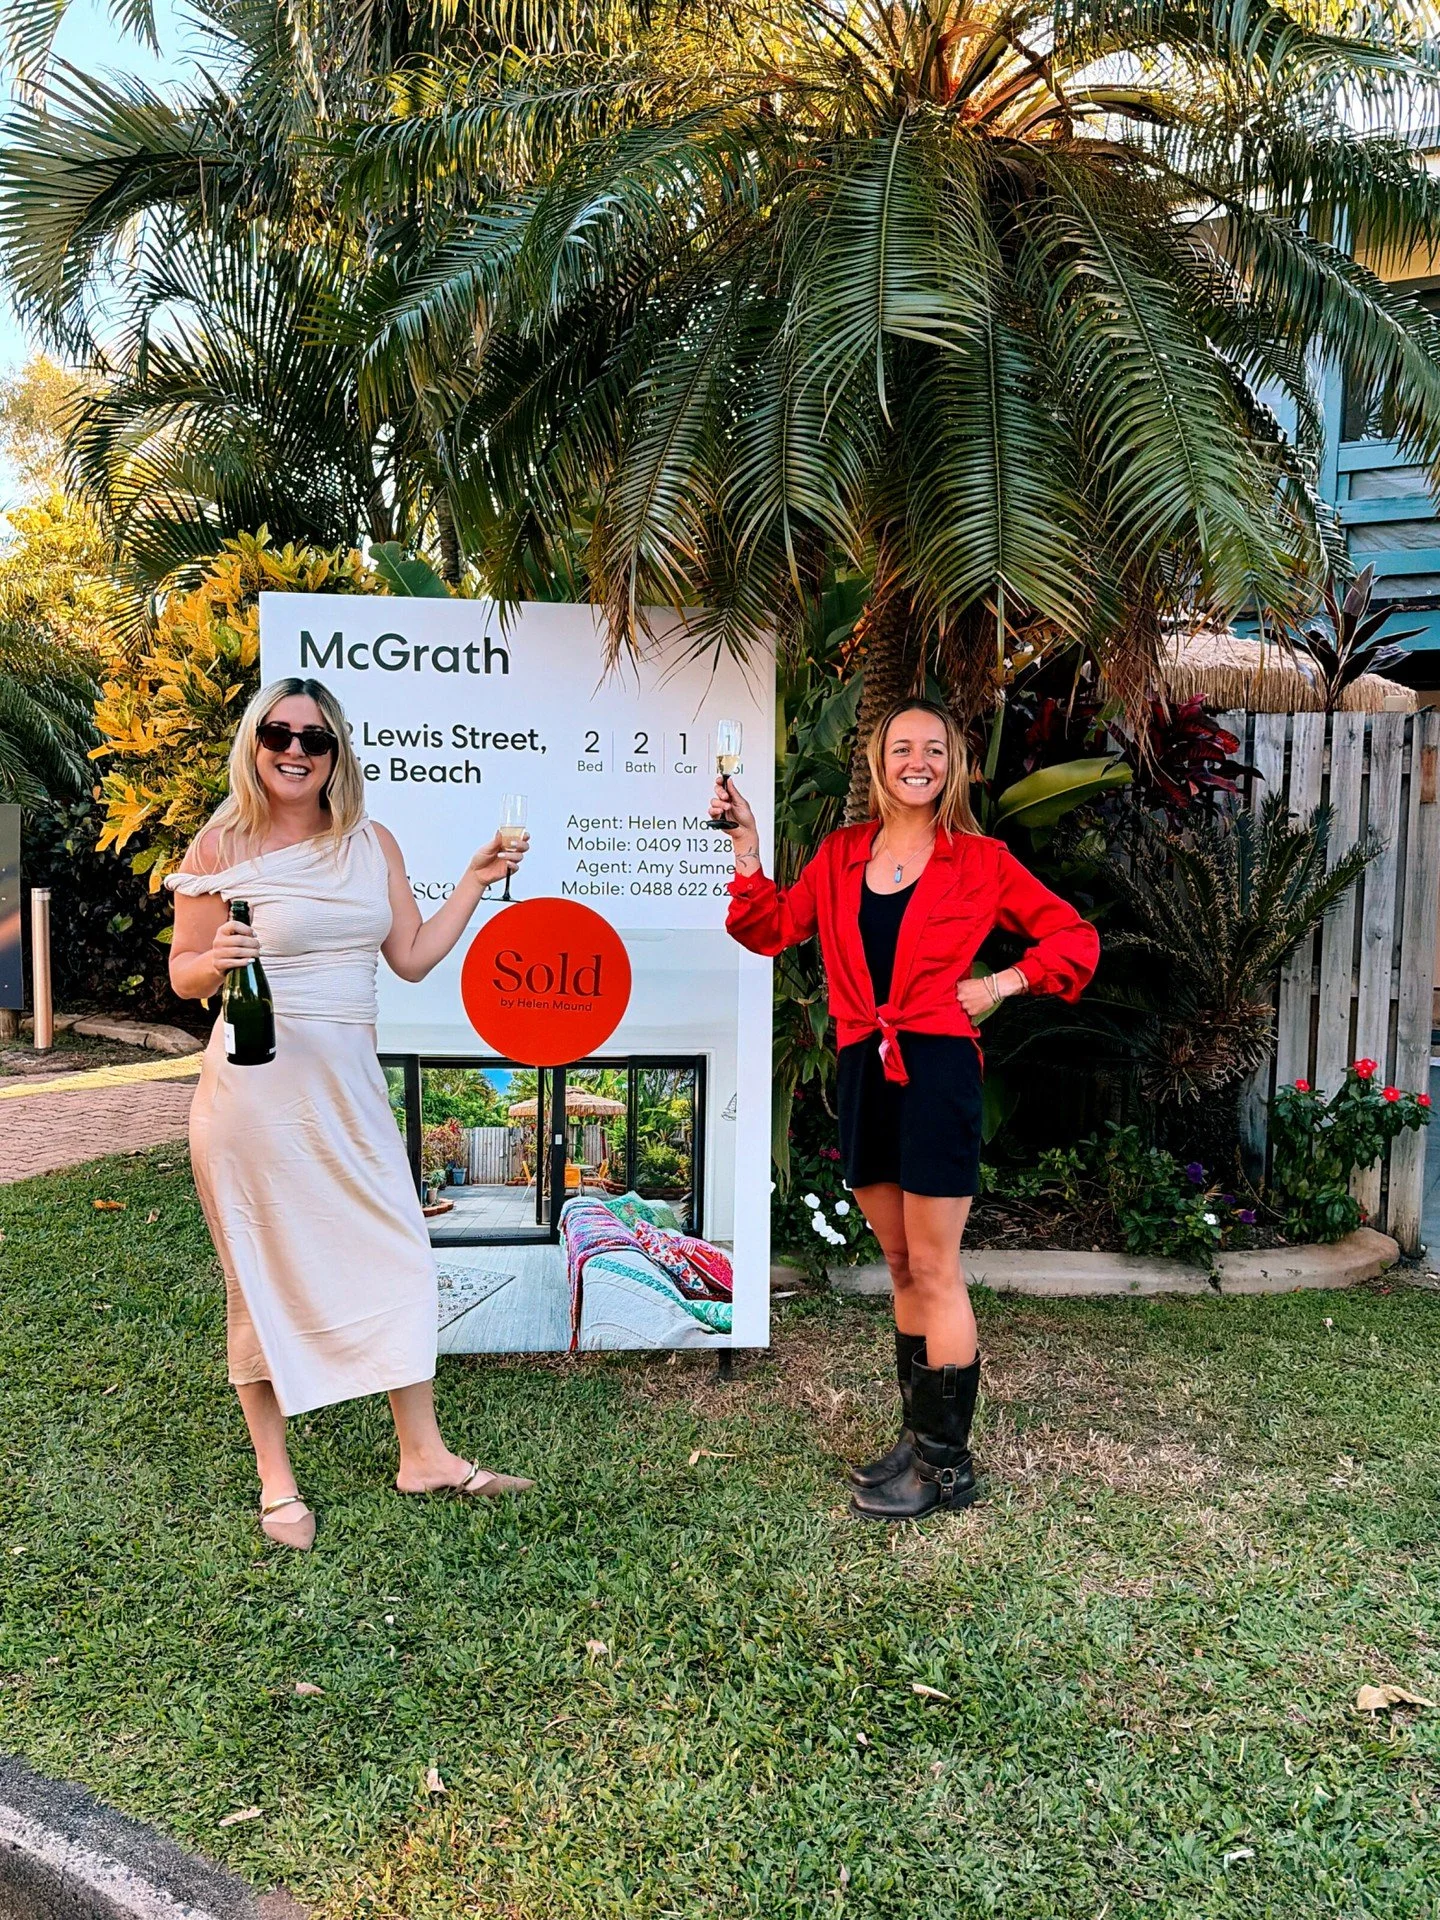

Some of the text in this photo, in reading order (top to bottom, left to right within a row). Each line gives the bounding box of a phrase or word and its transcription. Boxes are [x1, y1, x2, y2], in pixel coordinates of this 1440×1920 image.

[300, 630, 510, 675] McGrath
[363, 721, 444, 748] Lewis
[451, 724, 547, 755] Street,
[584, 730, 600, 753] 2
[633, 731, 649, 755] 2
[679, 732, 687, 755] 1
[390, 757, 482, 784] Beach
[577, 760, 698, 774] Bed Bath Car
[566, 814, 623, 833] Agent:
[628, 815, 677, 830] Helen
[567, 836, 734, 853] Mobile: 0409 113 28
[575, 859, 736, 878] Agent: Amy Sumne
[561, 880, 732, 897] Mobile: 0488 622 62
[492, 950, 603, 997] Sold
[500, 998, 593, 1012] by Helen Maund
